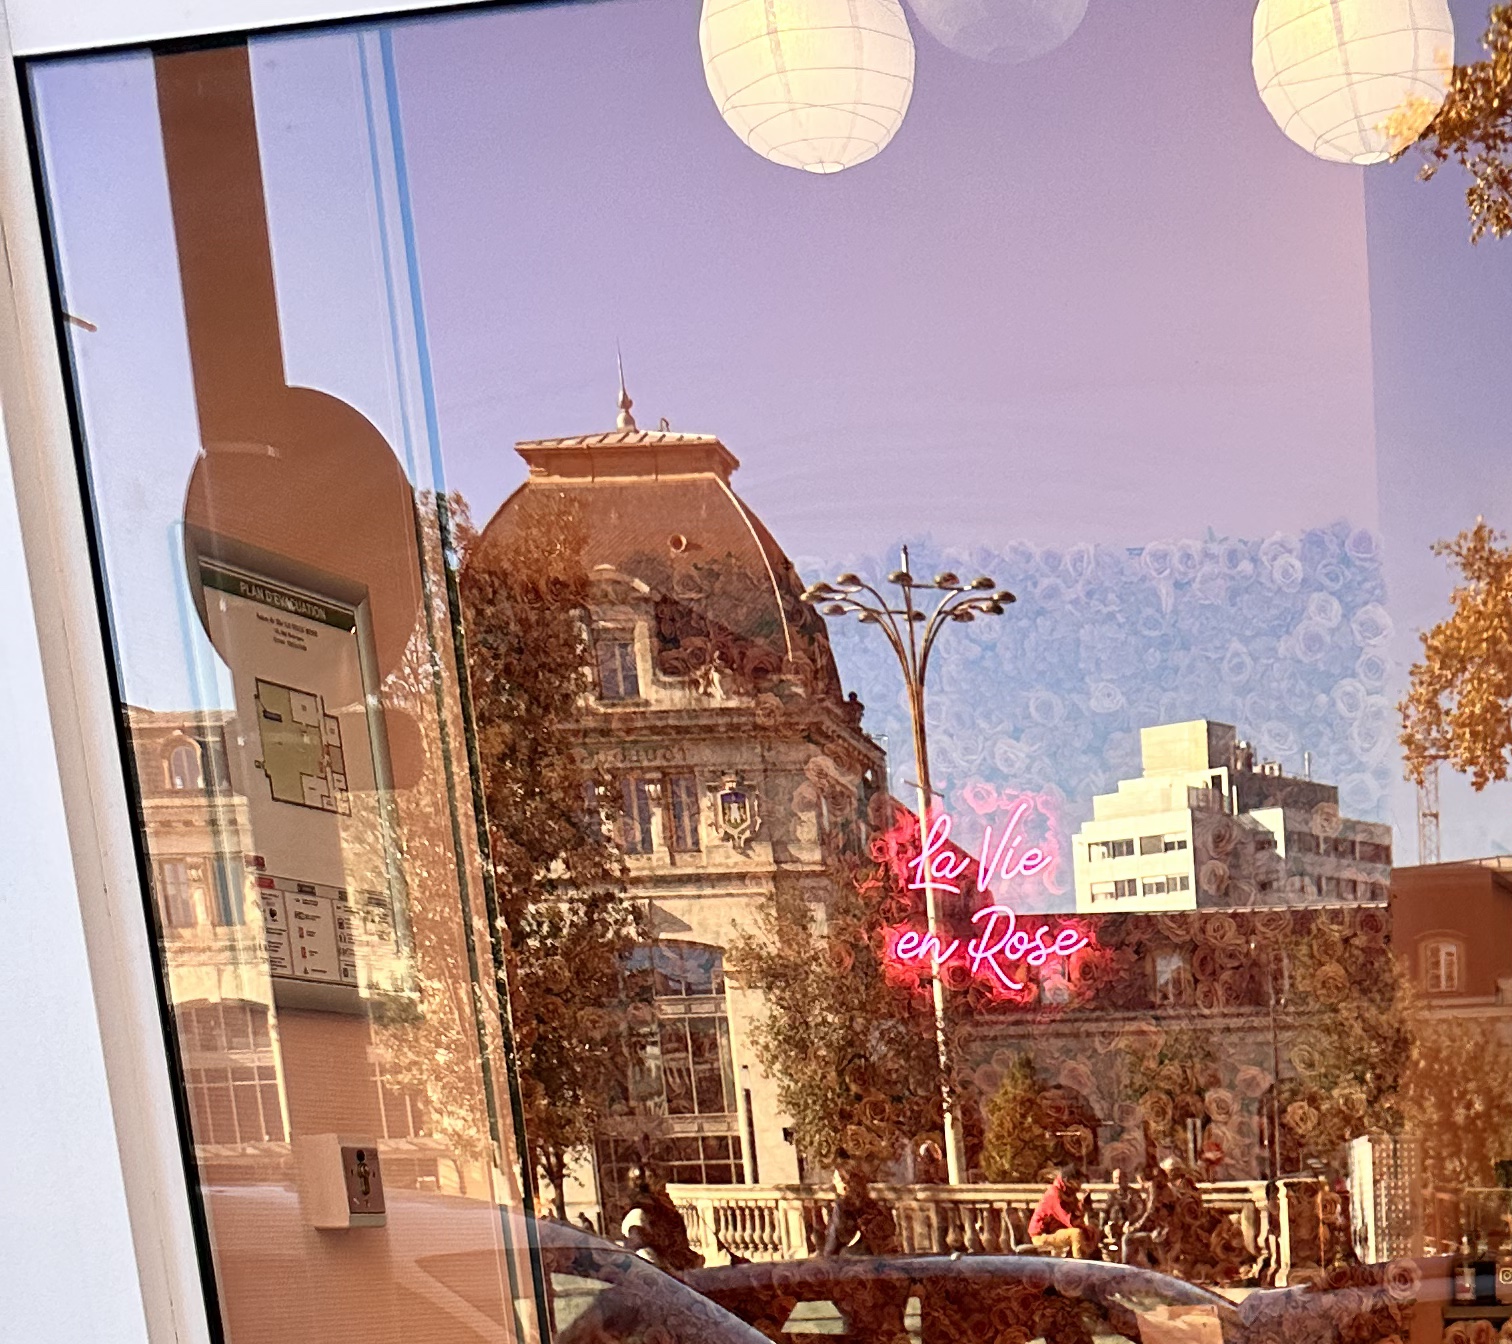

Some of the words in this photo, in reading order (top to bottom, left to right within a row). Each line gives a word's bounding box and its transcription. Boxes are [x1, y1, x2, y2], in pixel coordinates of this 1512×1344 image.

[240, 581, 265, 601] PLAN
[908, 815, 970, 893] La
[977, 803, 1051, 892] Vie
[896, 930, 959, 964] en
[967, 905, 1088, 990] Rose
